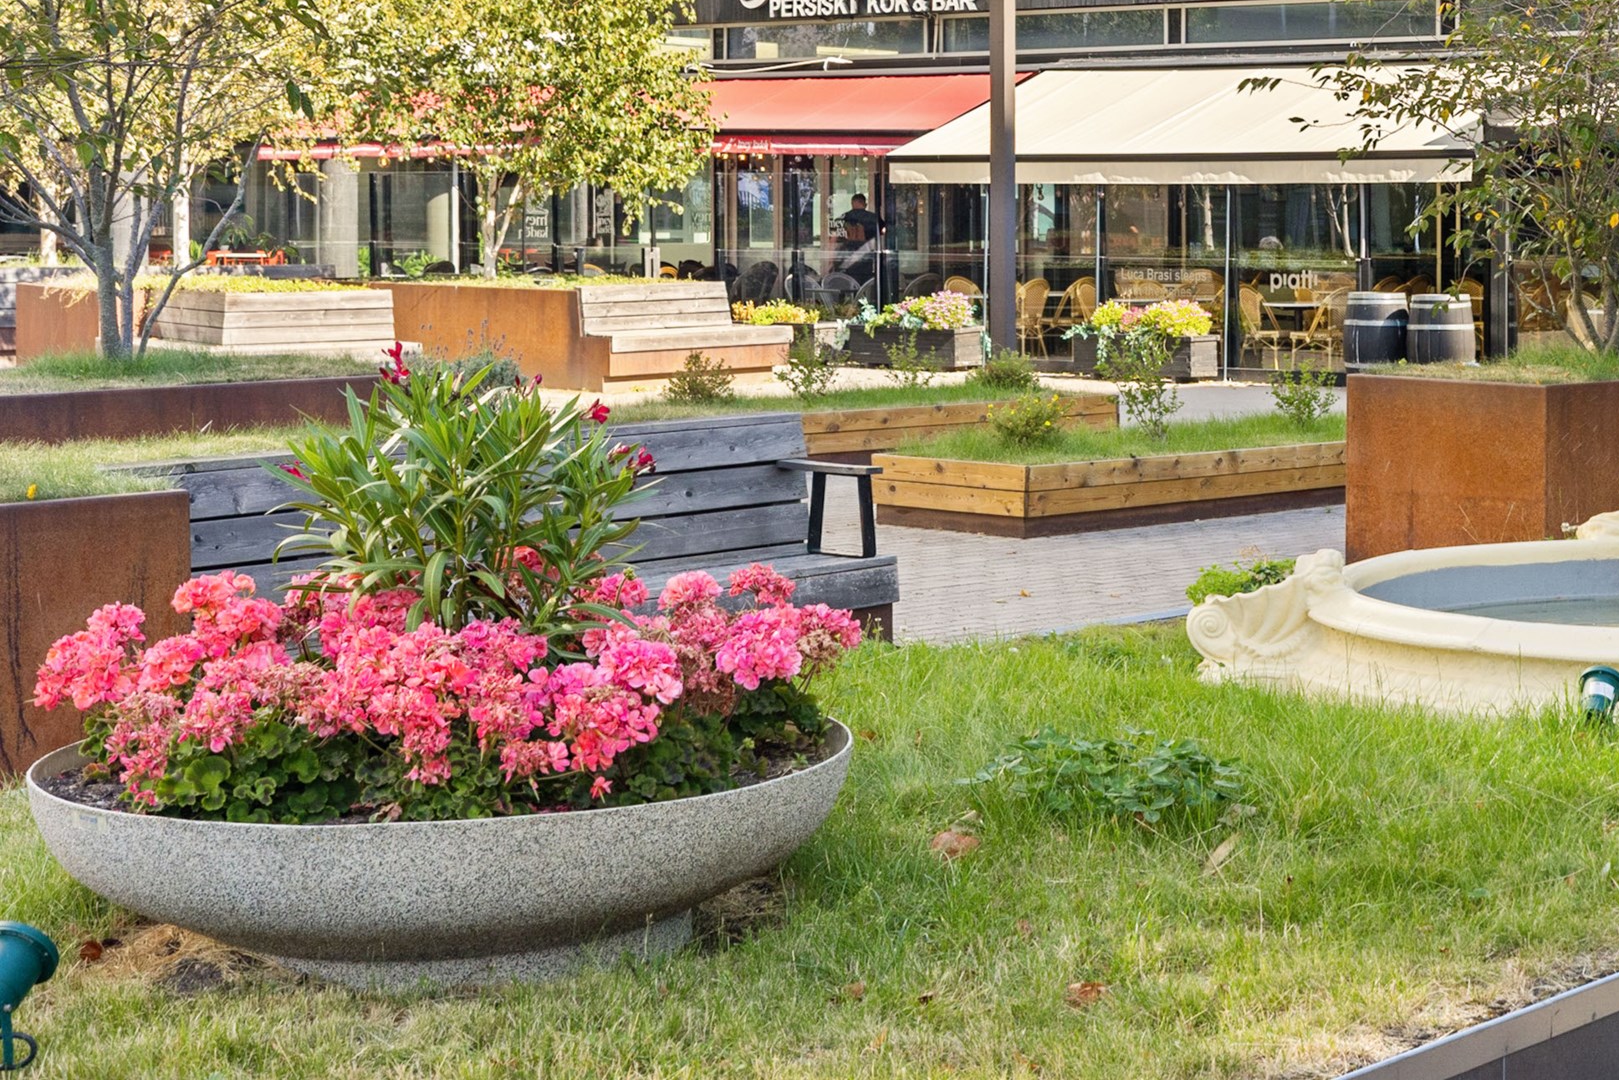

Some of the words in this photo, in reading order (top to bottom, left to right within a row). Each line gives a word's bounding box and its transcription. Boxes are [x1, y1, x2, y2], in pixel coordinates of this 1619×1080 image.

[1121, 267, 1144, 280] Luca
[1147, 267, 1173, 281] Brasi
[1269, 269, 1318, 293] piatti
